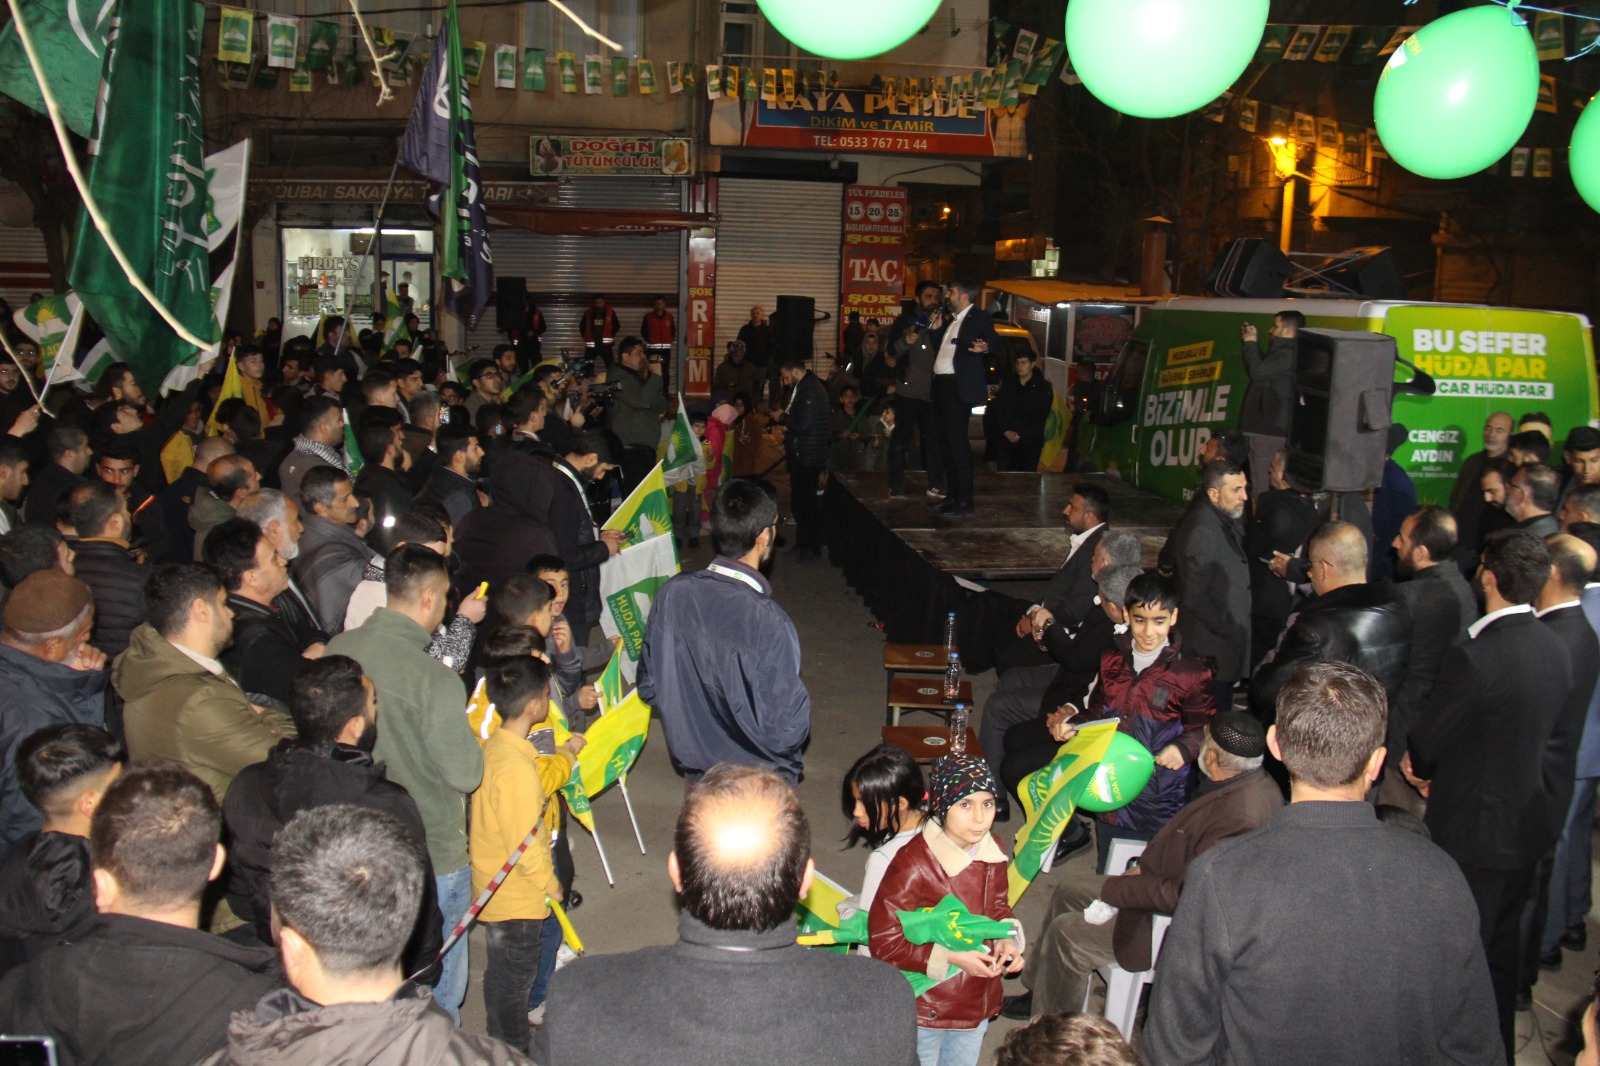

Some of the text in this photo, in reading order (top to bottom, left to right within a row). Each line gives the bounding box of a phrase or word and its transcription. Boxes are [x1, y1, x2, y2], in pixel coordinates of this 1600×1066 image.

[860, 119, 878, 131] ve
[570, 138, 654, 153] DOĞAN
[813, 134, 928, 151] TEL: 0533 767 71 44
[849, 206, 900, 218] 15 20 25
[849, 258, 898, 286] TAÇ
[848, 293, 897, 306] ŞOK
[1413, 328, 1547, 356] BU SEFER
[1414, 354, 1547, 379] HÜDA PAR
[1473, 383, 1516, 395] HÜDA
[1518, 385, 1547, 397] PAR
[1410, 449, 1454, 462] AYDIN
